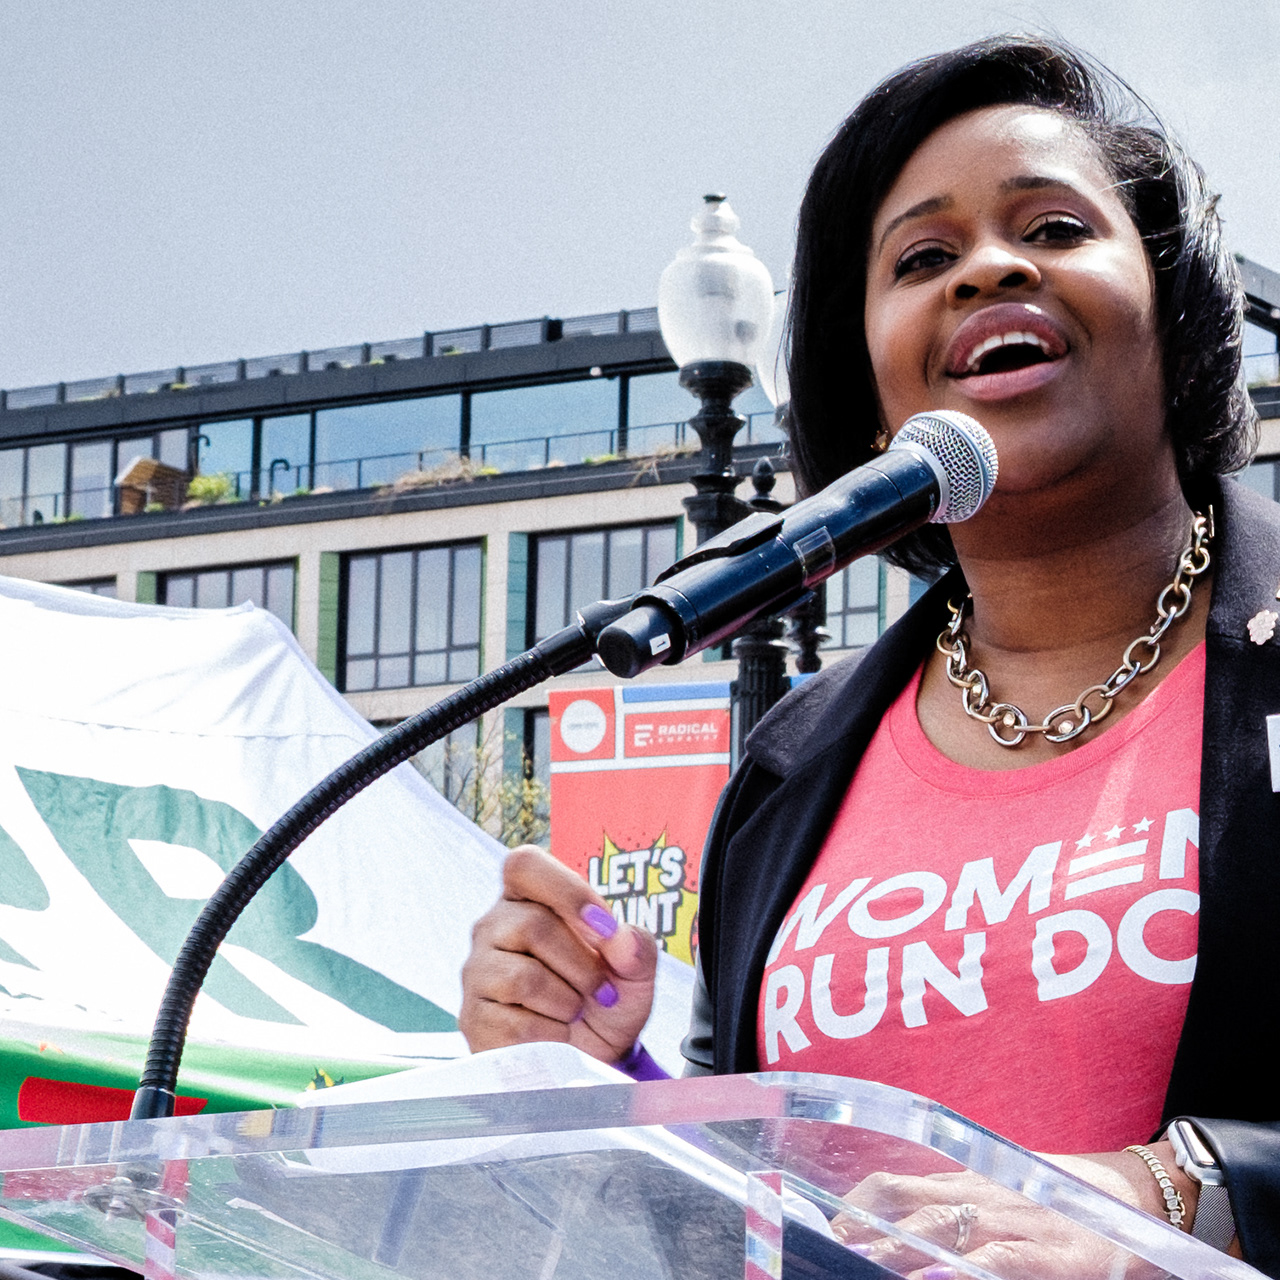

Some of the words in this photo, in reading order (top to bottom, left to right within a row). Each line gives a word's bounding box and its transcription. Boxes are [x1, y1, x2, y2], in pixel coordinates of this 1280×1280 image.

[658, 723, 718, 736] RADICAL
[589, 846, 684, 897] LET'S
[612, 891, 680, 934] AINT
[765, 931, 989, 1064] RUN
[1032, 888, 1200, 1002] DC
